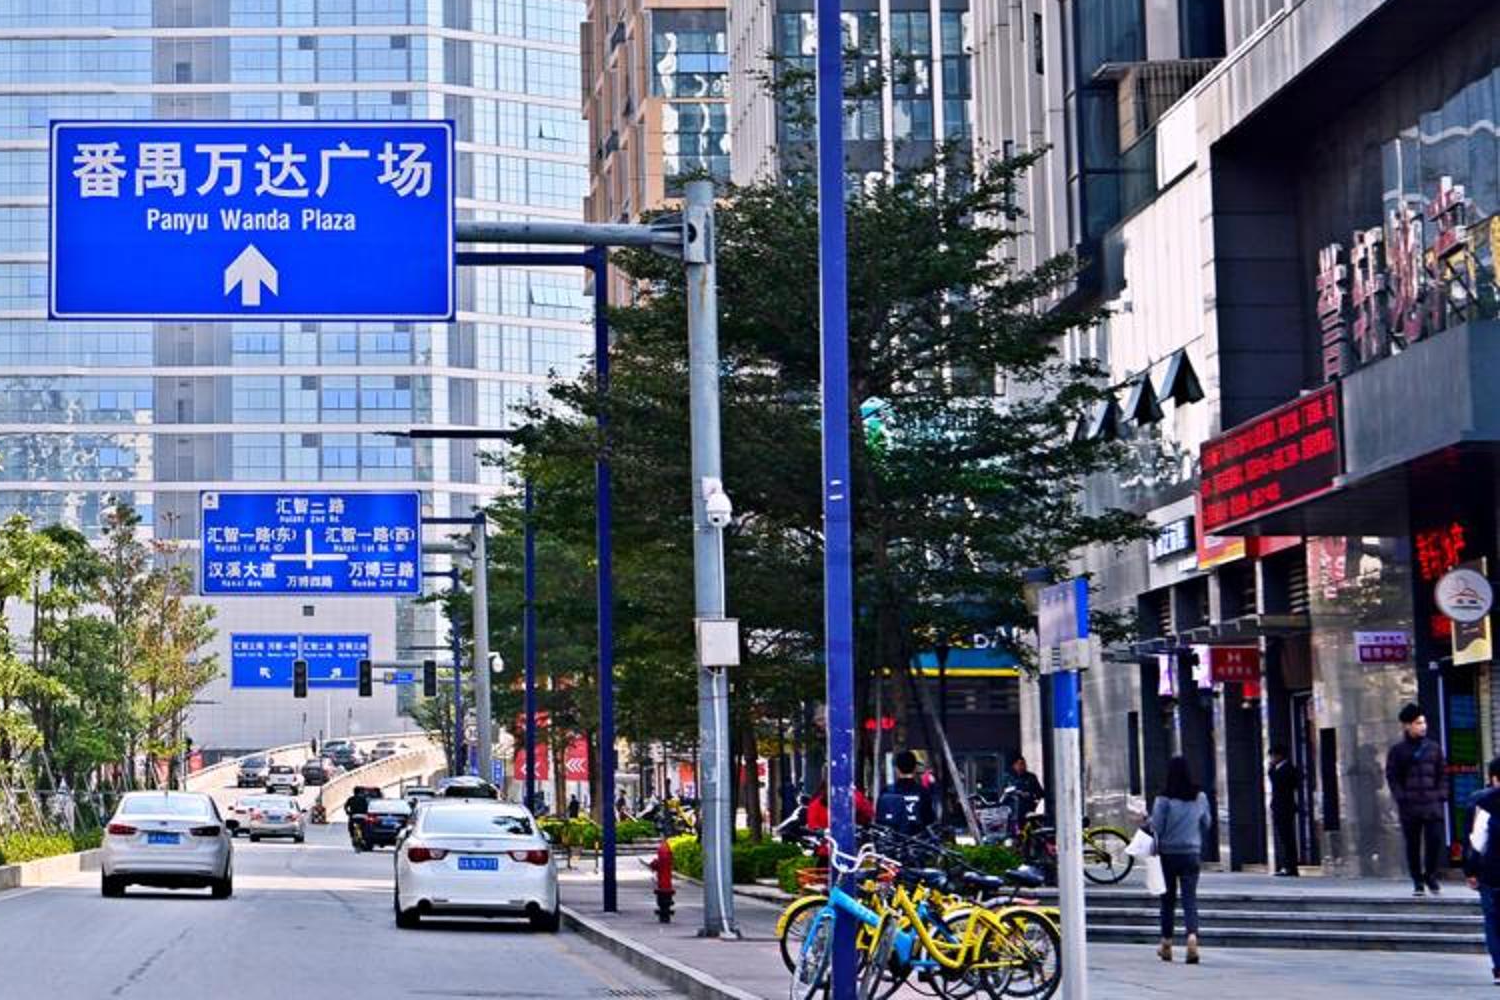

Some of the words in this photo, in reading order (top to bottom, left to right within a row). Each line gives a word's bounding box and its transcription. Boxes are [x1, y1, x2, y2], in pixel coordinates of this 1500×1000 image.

[73, 142, 432, 198] 番禺万达广场
[147, 208, 208, 234] Panyu
[220, 208, 290, 231] Wanda
[302, 208, 356, 231] Plaza
[276, 497, 344, 514] 汇智二路
[348, 561, 415, 578] 万博三路
